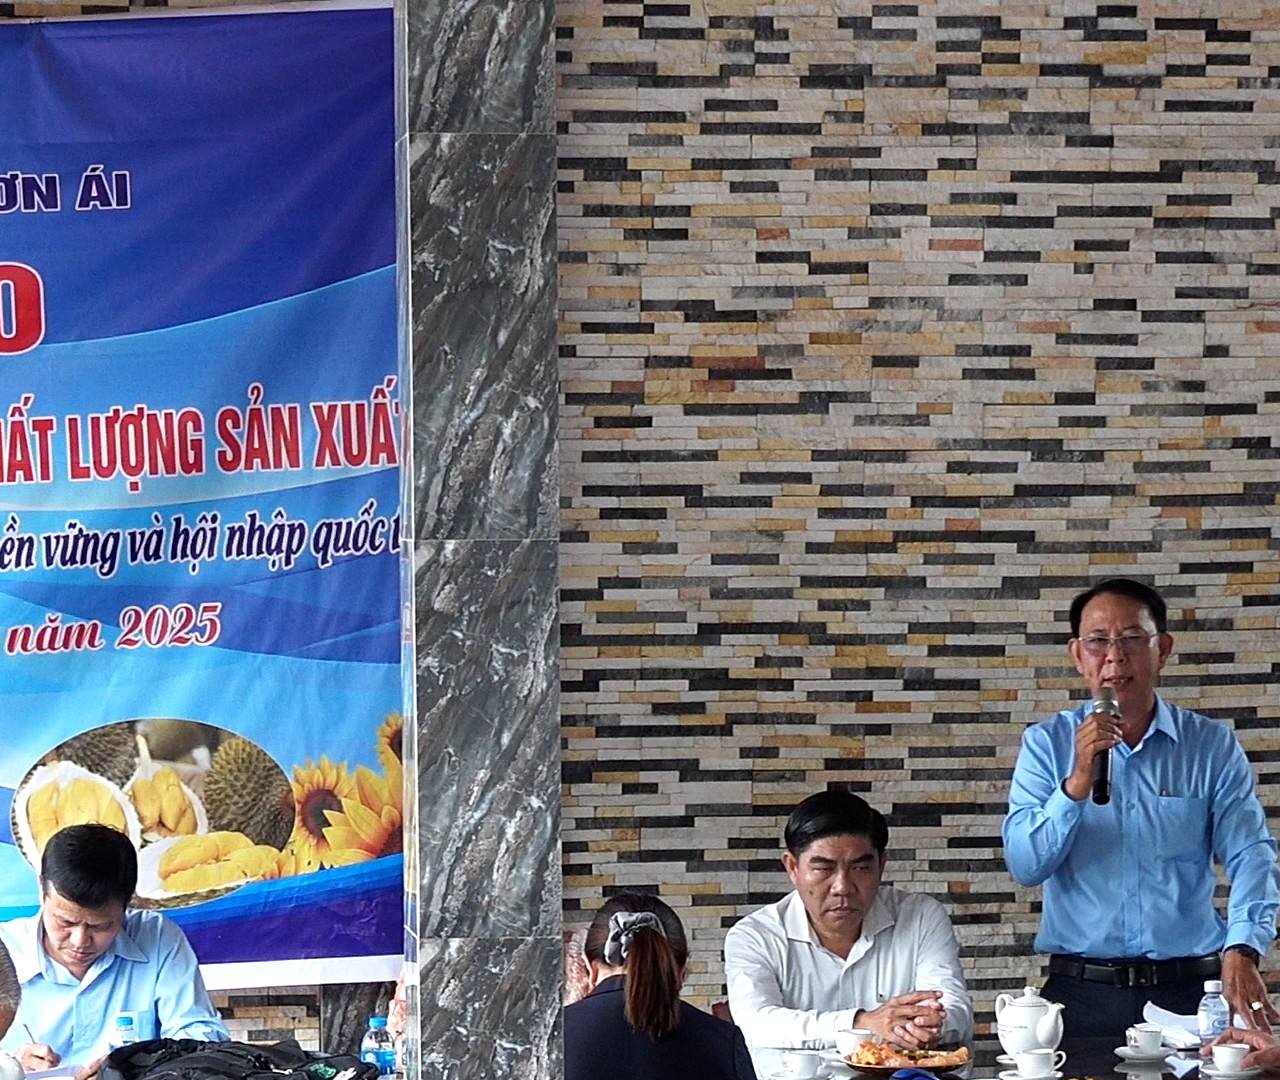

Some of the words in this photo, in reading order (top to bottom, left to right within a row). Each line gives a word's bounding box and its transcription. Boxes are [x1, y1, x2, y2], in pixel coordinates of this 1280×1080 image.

[76, 165, 131, 210] ÁI
[67, 409, 203, 494] LƯỢNG
[217, 383, 299, 473] SẢN
[43, 519, 117, 578] vững
[129, 524, 164, 563] và
[172, 514, 217, 572] hội
[225, 508, 305, 574] nhập
[313, 499, 388, 565] quốc
[7, 615, 103, 652] năm
[118, 602, 221, 647] 2025
